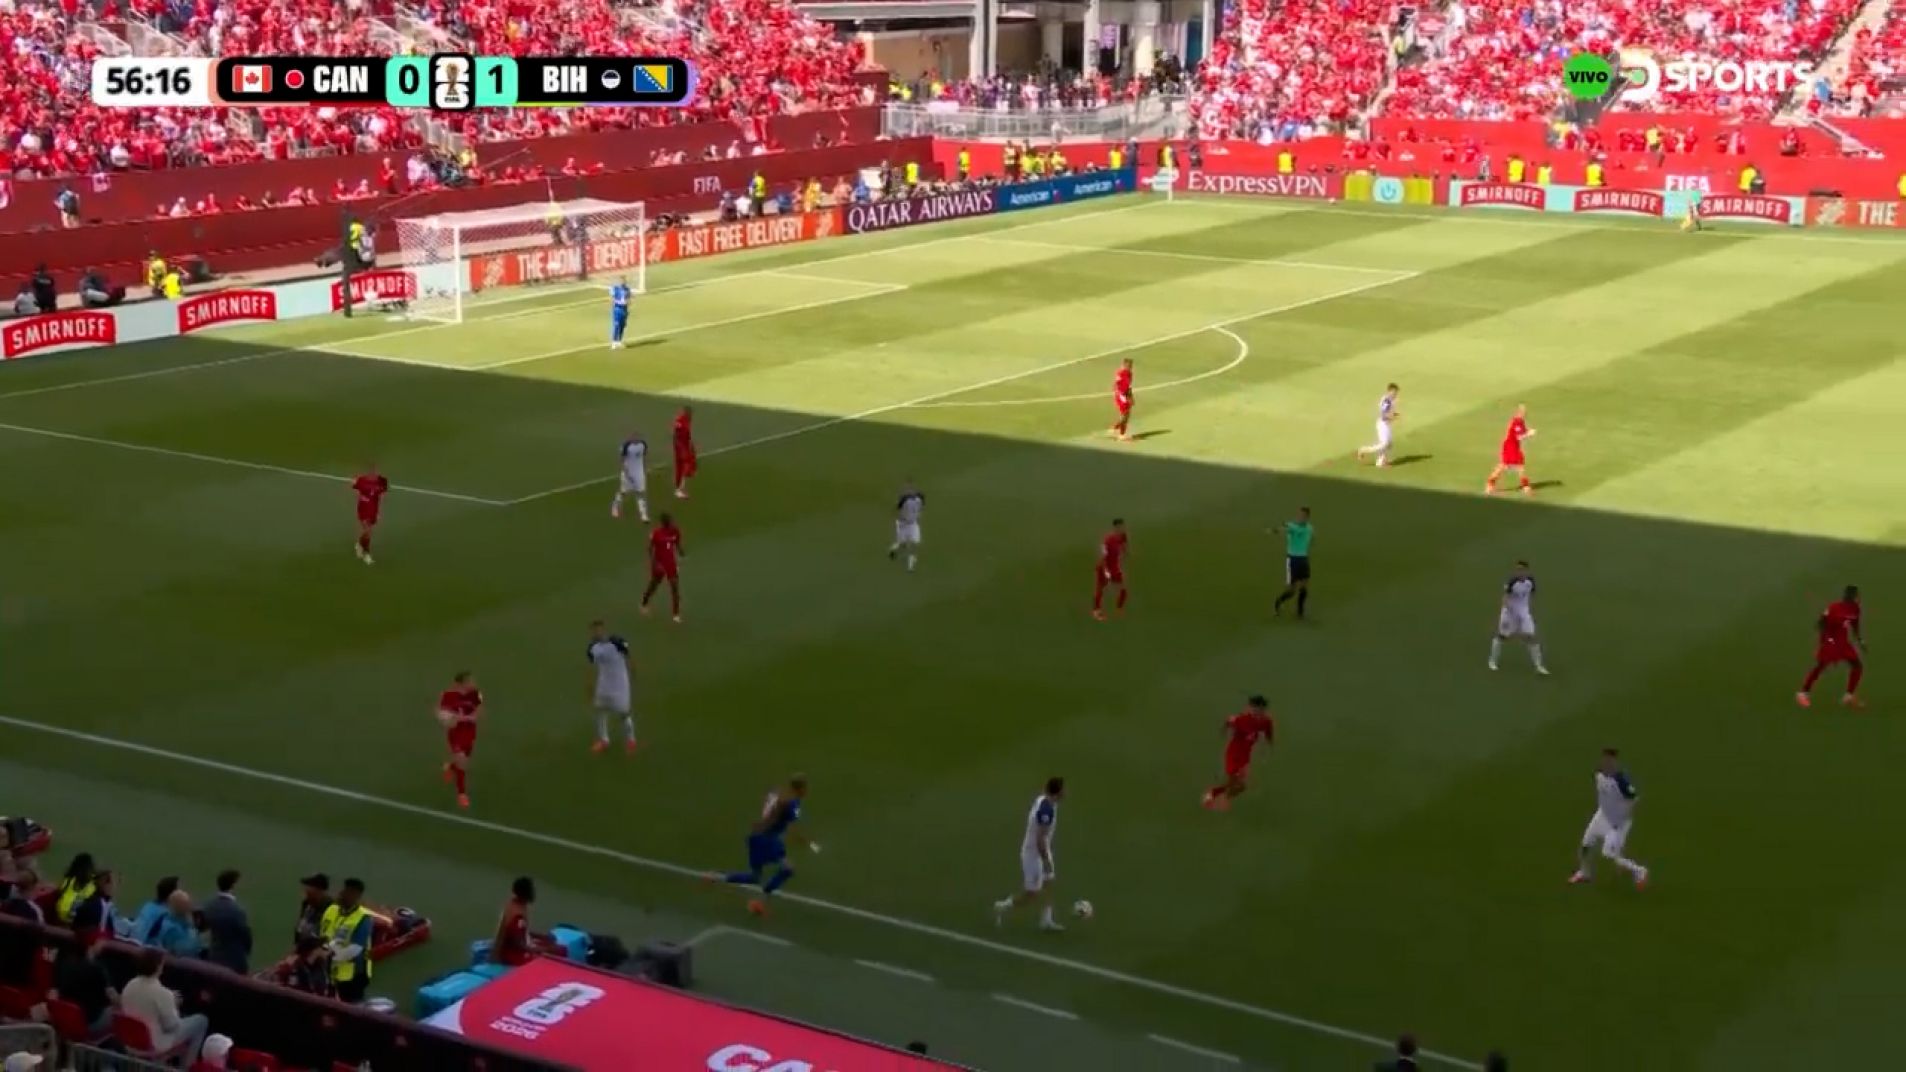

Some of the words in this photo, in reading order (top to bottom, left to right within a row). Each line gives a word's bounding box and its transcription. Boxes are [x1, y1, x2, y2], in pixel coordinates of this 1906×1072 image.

[694, 176, 721, 194] FIFA
[1074, 179, 1113, 195] American
[1188, 170, 1327, 196] ExpressVPN
[1665, 175, 1711, 192] FIFA
[1010, 189, 1050, 205] American
[1467, 187, 1540, 205] SMIRNOFF
[1581, 192, 1658, 211] SMIRNOFF
[850, 201, 911, 232] QATAR
[919, 190, 993, 220] AIRWAYS
[1702, 198, 1785, 217] SMIRNOFF
[1858, 200, 1900, 226] THE
[678, 227, 710, 257] FAST
[713, 222, 744, 251] FREE
[747, 215, 804, 246] DELIVERY
[517, 250, 546, 281] THE
[594, 238, 638, 269] DEPOT
[186, 295, 269, 326] SMIRNOFF
[12, 317, 108, 350] SMIRNOFF
